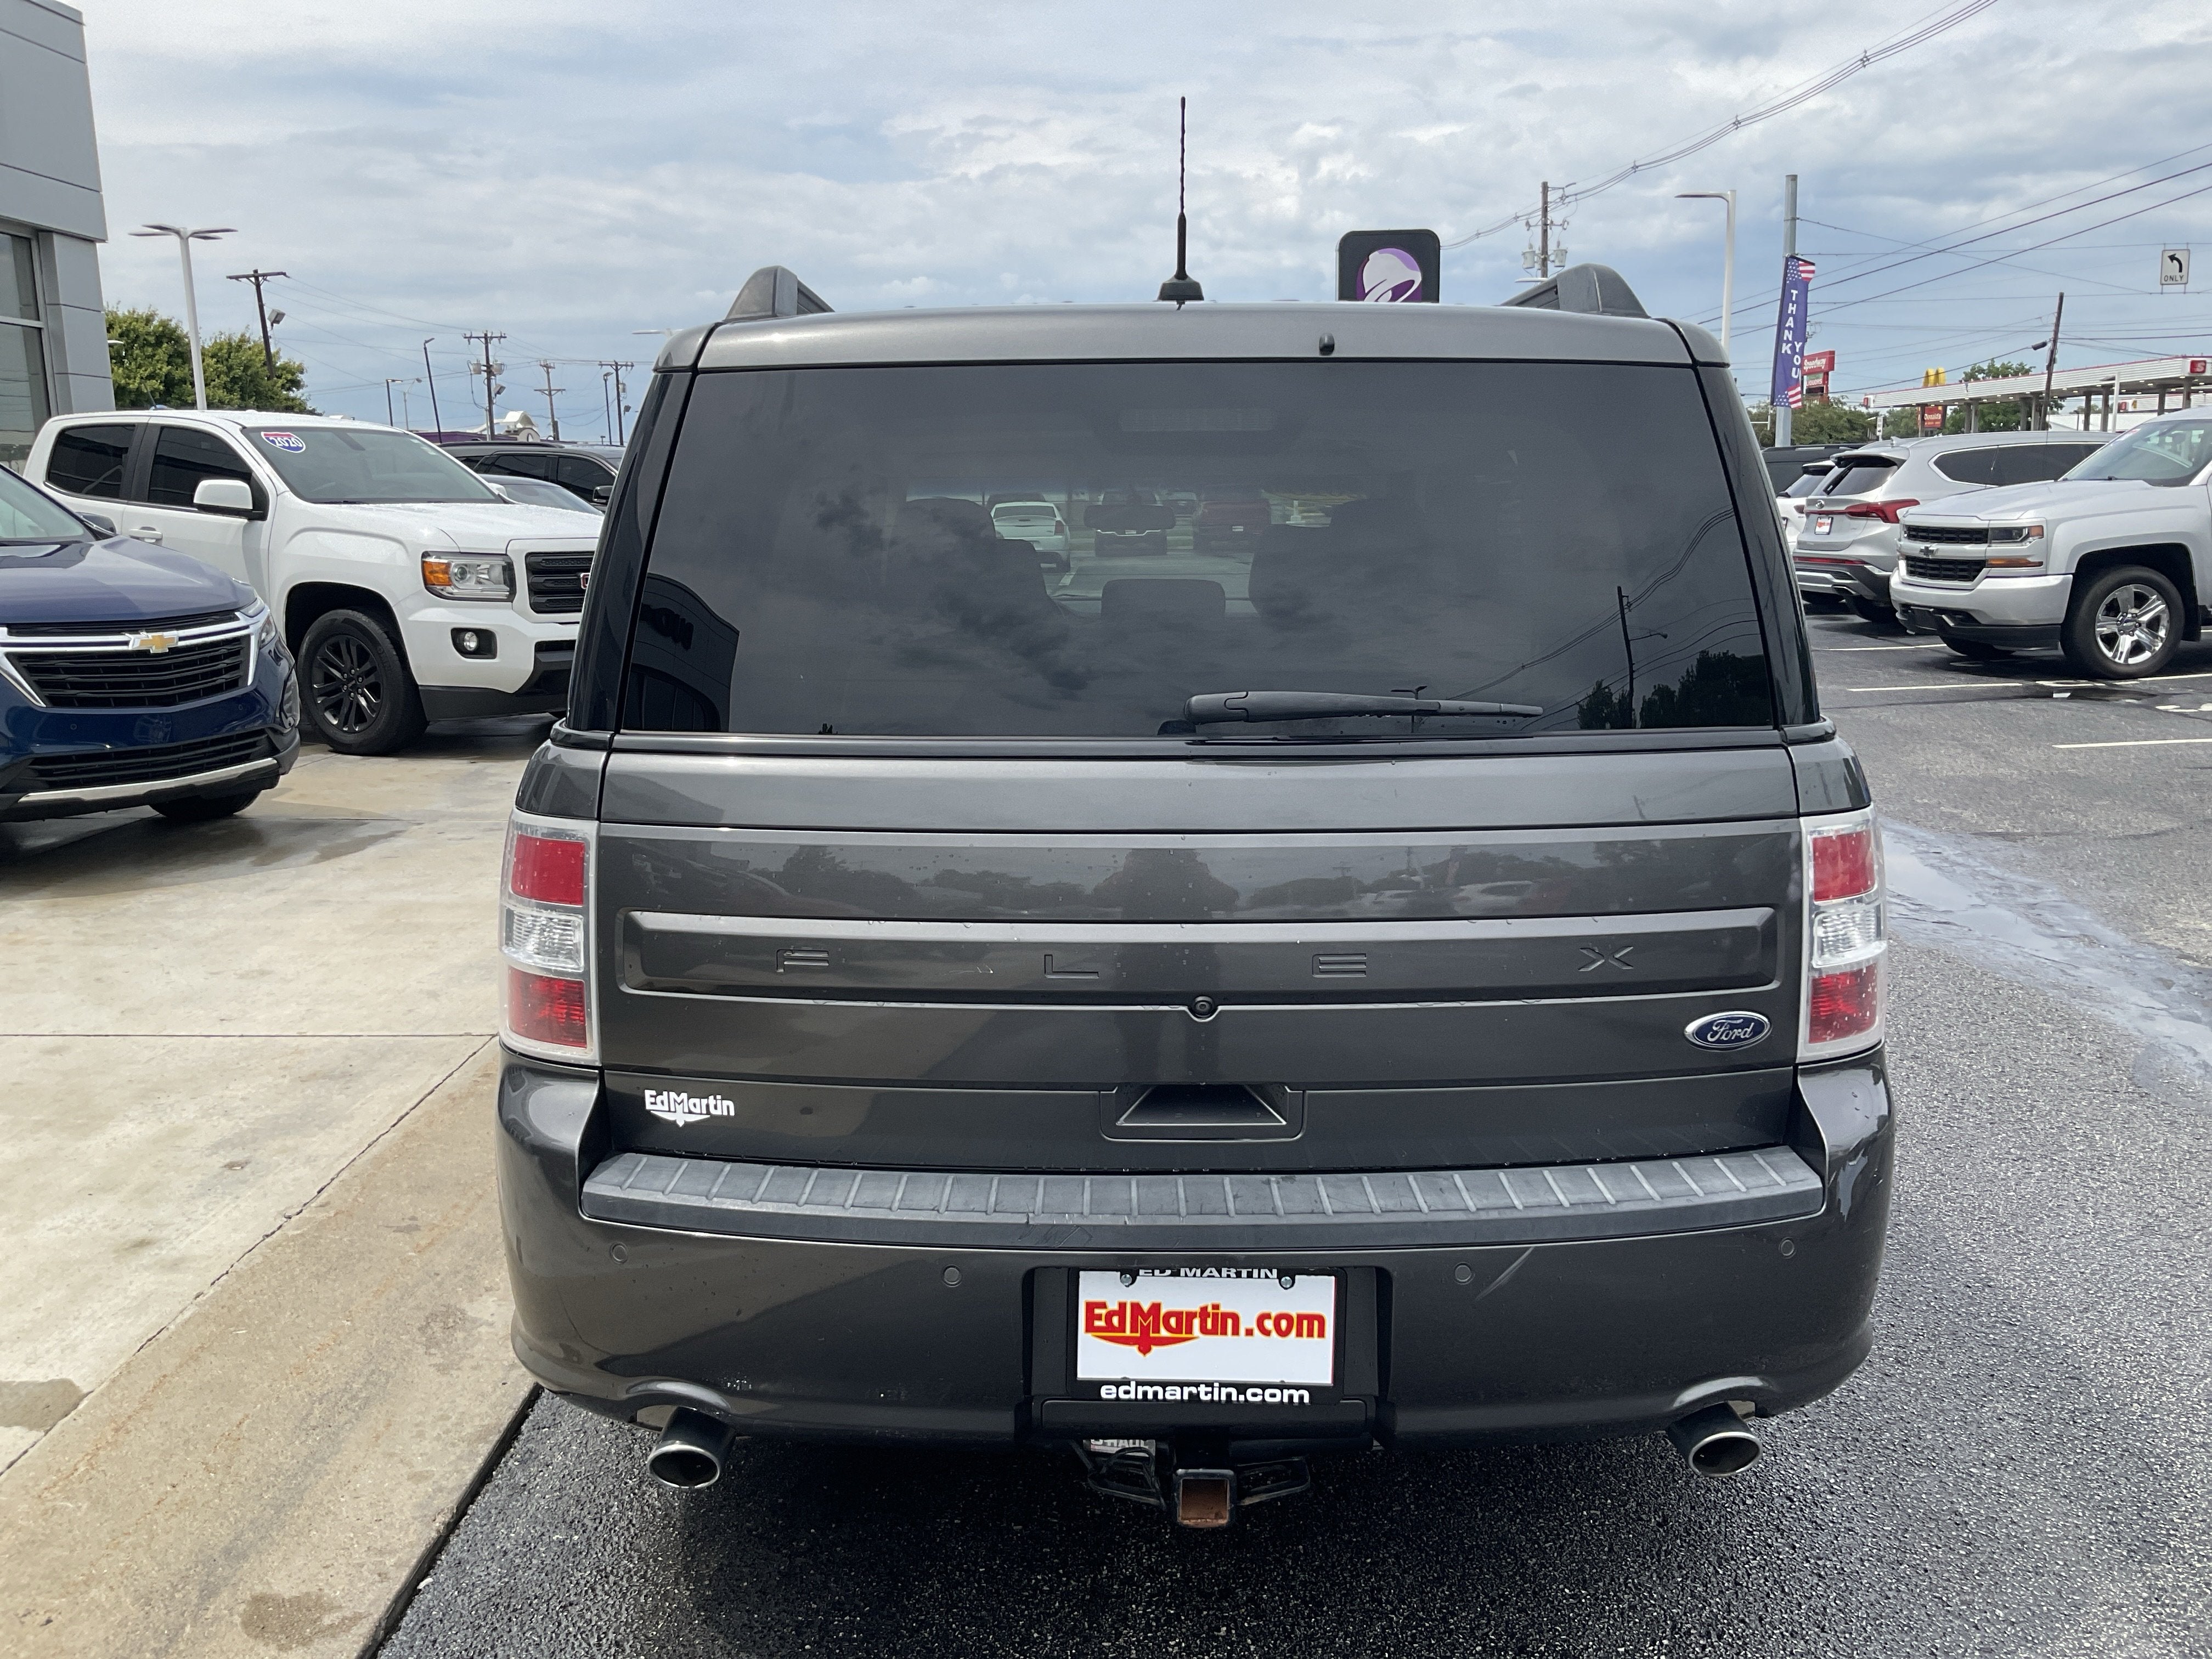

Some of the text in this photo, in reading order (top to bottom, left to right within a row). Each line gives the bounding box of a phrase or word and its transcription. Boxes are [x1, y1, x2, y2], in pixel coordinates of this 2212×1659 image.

[1781, 289, 1798, 354] THANK
[1791, 341, 1803, 379] YOU
[1804, 357, 1826, 372] Speedway
[269, 437, 303, 447] 2020
[1707, 1019, 1755, 1042] Ford
[644, 1089, 735, 1122] EdMartin
[1180, 1267, 1278, 1279] MARTIN
[1084, 1300, 1327, 1345] EdMartin.com
[1100, 1381, 1310, 1404] edmartin.com
